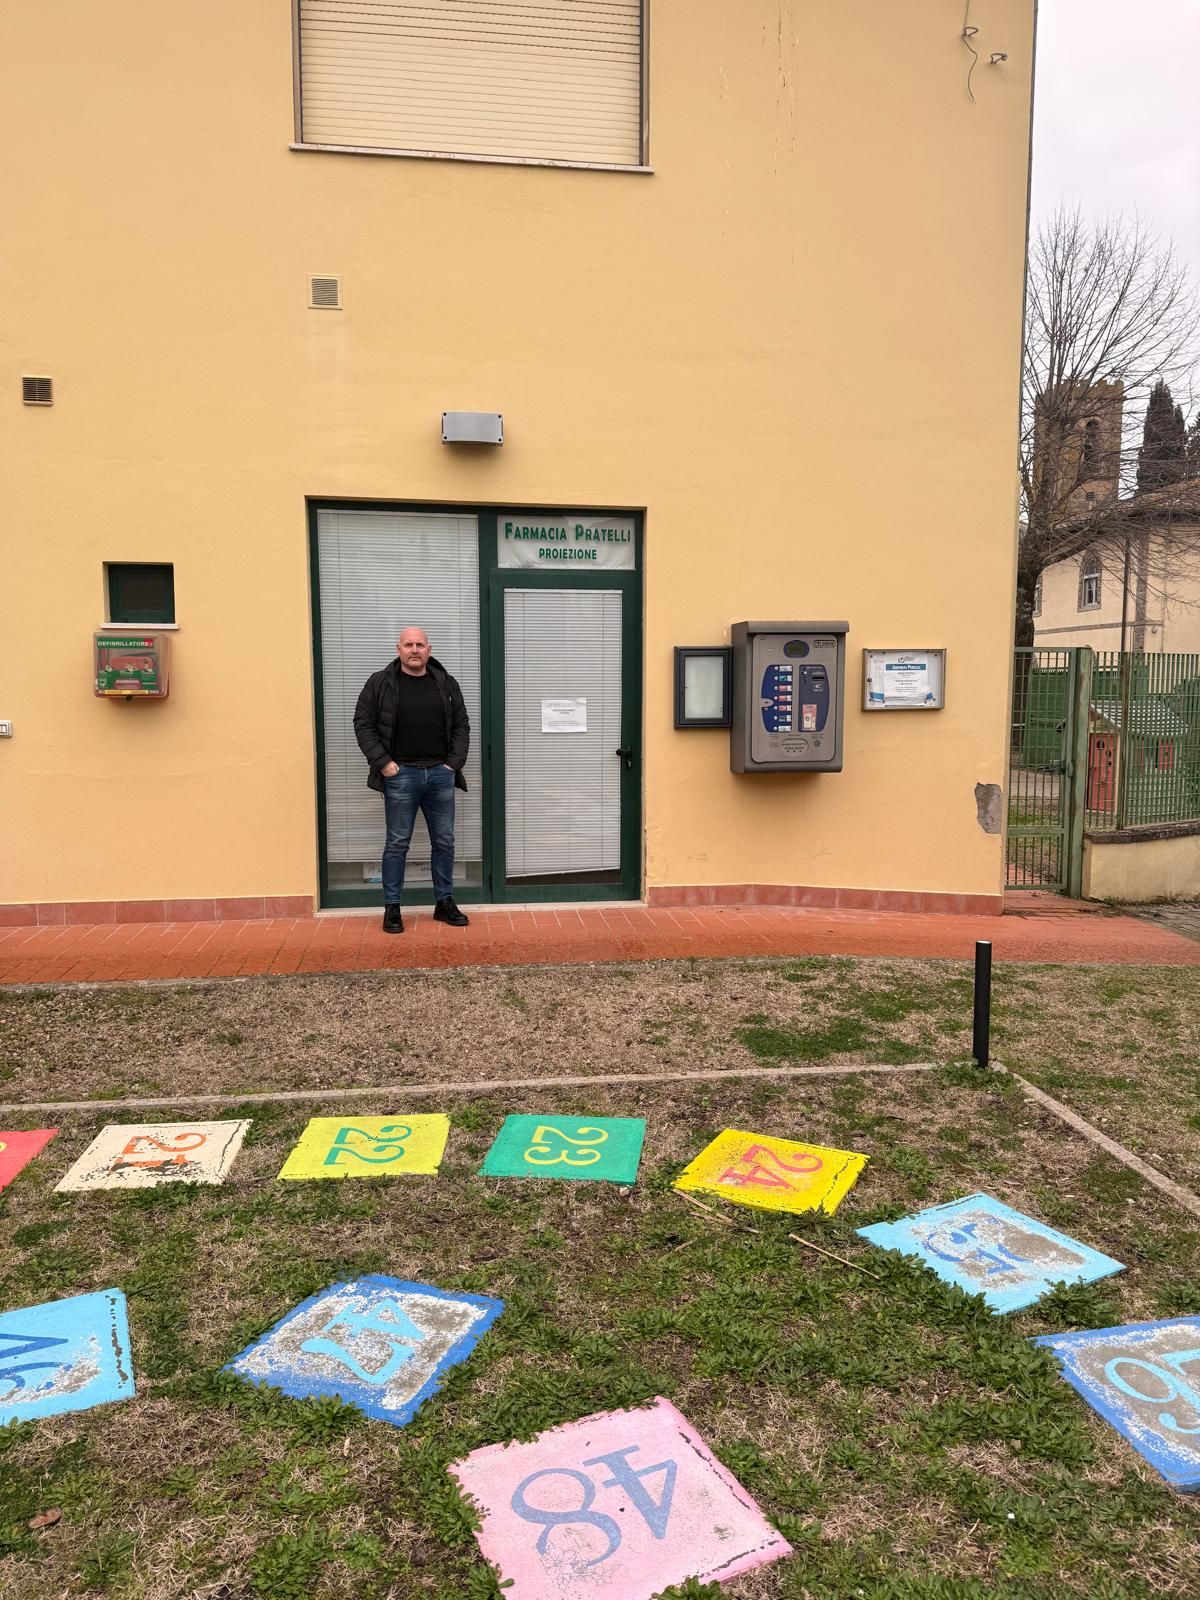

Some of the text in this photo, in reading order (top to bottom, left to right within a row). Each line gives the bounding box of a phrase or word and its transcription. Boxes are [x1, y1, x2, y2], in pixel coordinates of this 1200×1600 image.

[504, 522, 631, 542] FARMACIA PRATELLI
[539, 547, 597, 560] PROIEZIONE
[106, 1133, 207, 1177] 21
[323, 1124, 413, 1166] 22
[523, 1125, 610, 1167] 23
[718, 1144, 824, 1192] 24
[300, 1298, 426, 1386] 47
[510, 1444, 678, 1568] 48
